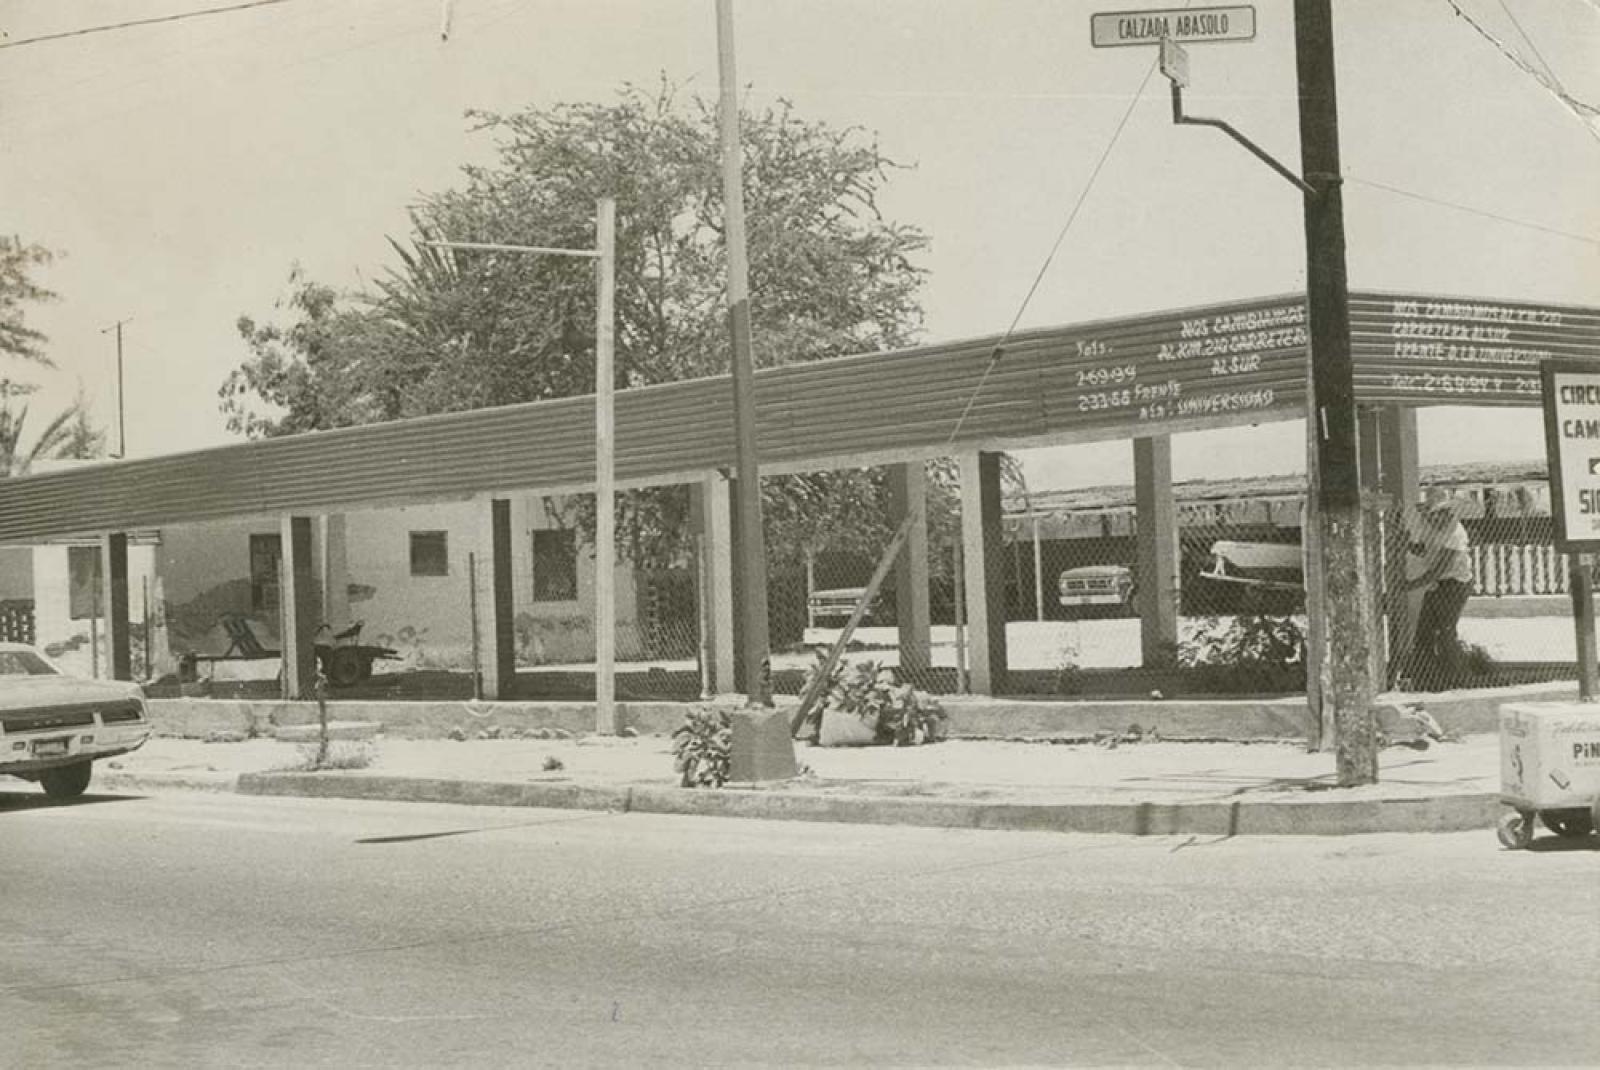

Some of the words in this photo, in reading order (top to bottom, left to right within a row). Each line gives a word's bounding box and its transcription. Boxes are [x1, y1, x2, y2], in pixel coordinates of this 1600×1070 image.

[1119, 17, 1170, 39] CALZADA
[1176, 14, 1229, 36] ABASOLO
[1231, 354, 1261, 374] SUR
